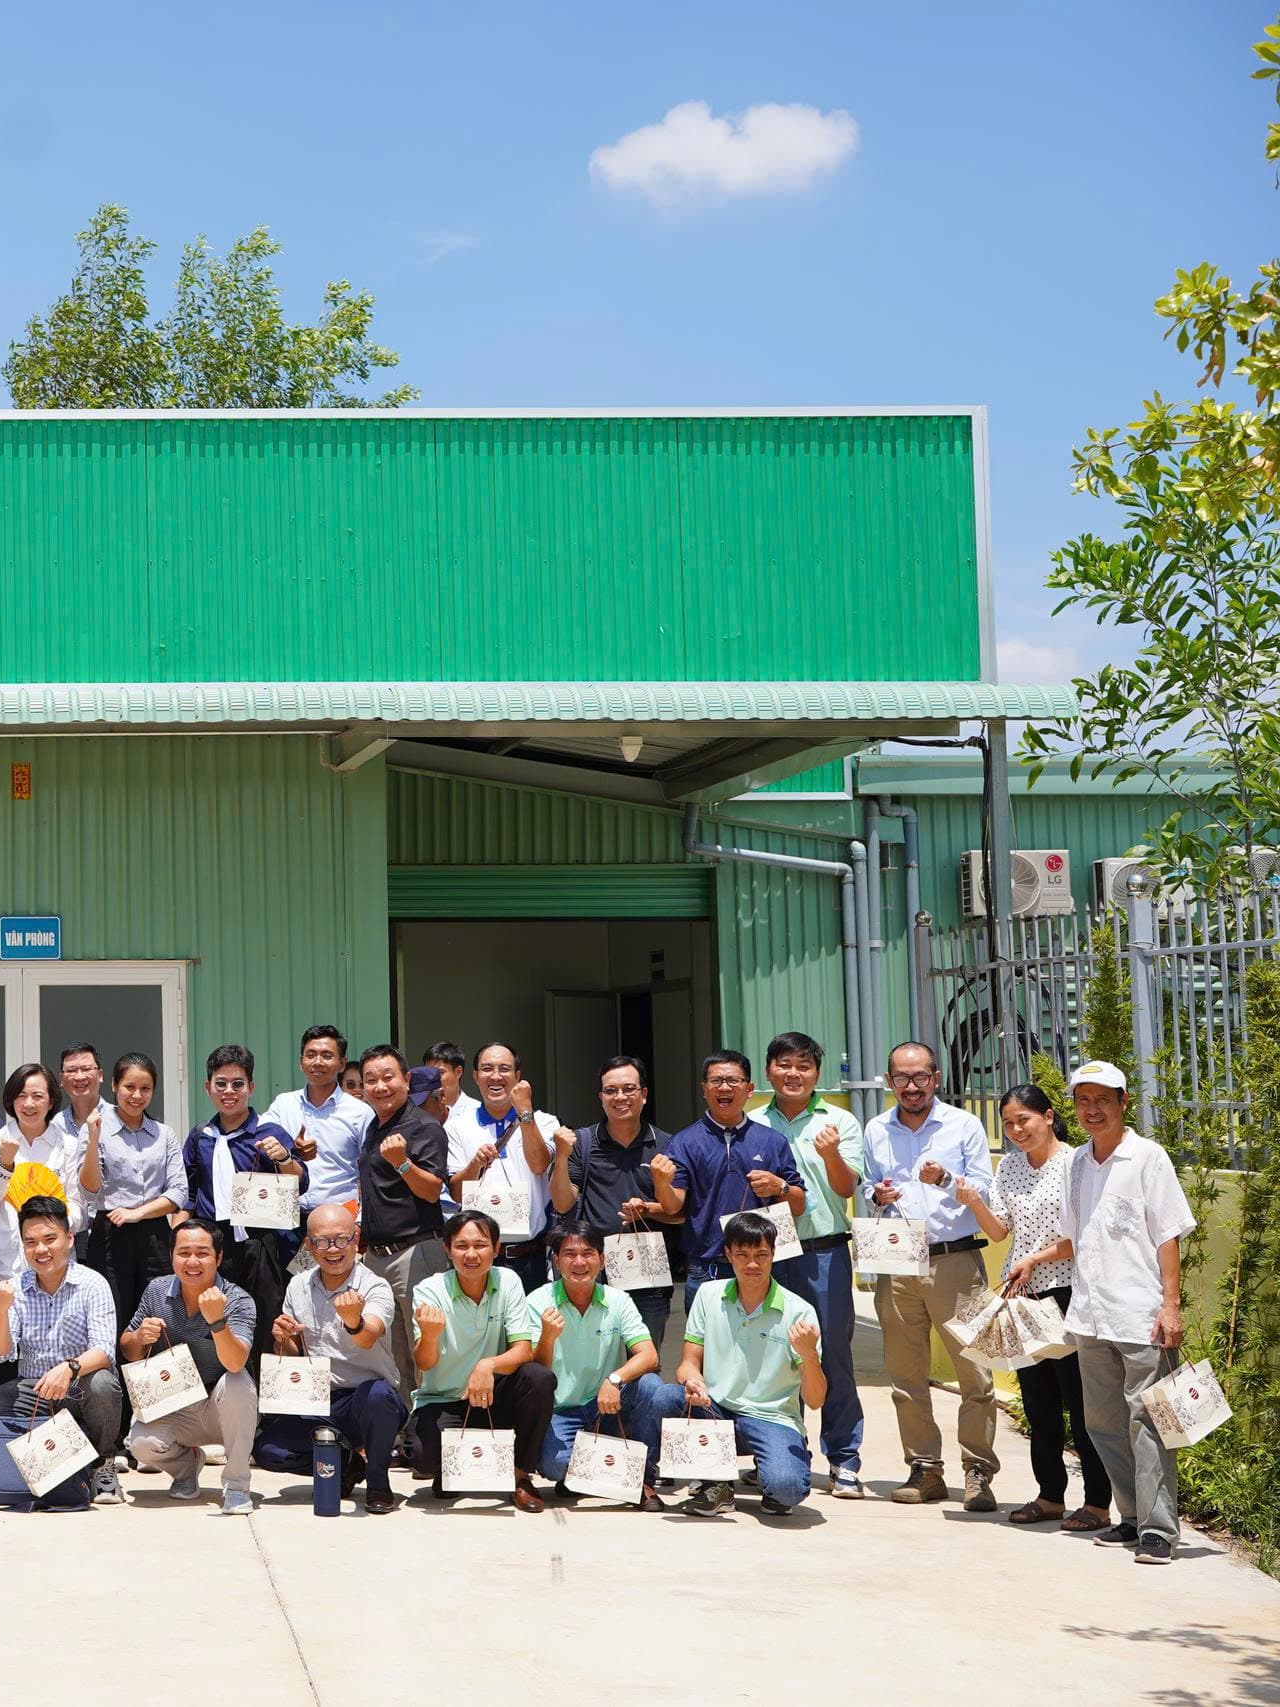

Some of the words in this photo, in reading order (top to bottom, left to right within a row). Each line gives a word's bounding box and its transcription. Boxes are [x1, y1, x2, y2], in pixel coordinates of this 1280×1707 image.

[1047, 874, 1063, 885] LG
[5, 930, 23, 946] VĂN
[25, 929, 56, 946] PHÒNG
